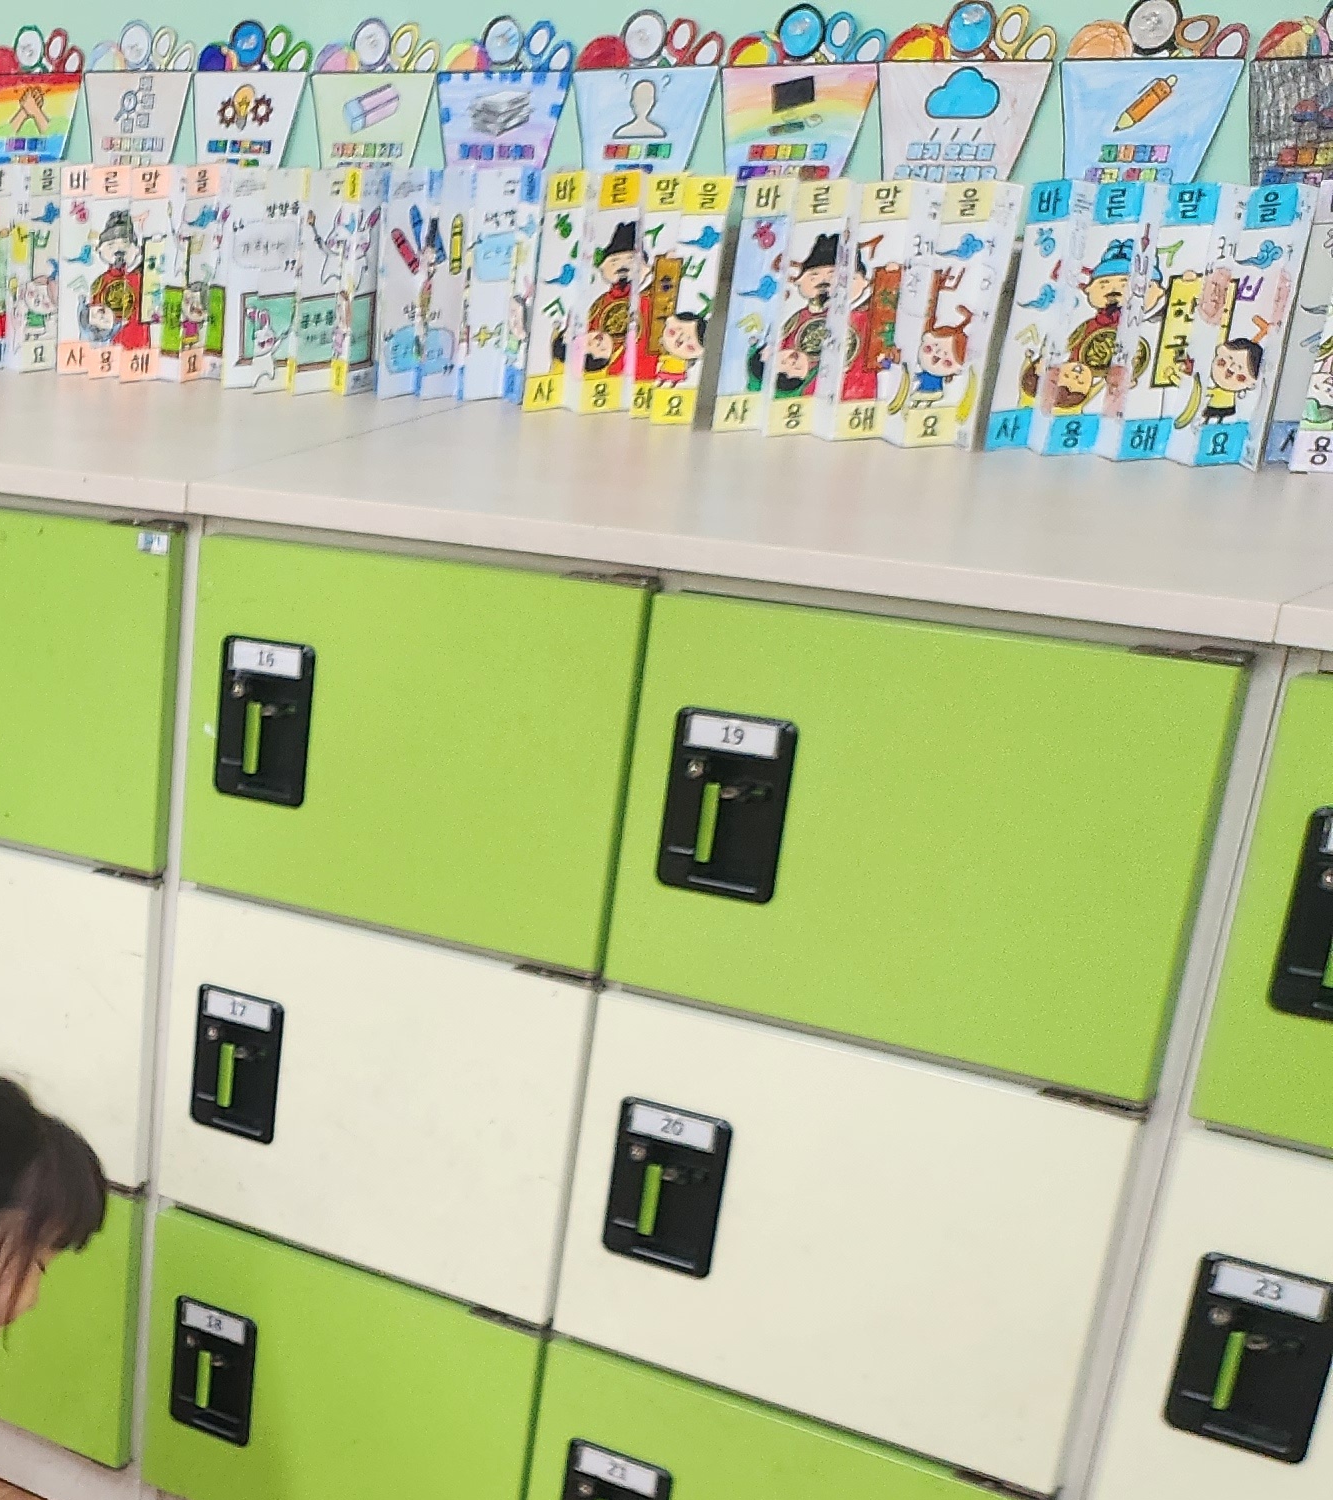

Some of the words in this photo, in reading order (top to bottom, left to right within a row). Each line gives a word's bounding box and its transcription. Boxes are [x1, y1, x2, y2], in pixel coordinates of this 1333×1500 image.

[723, 403, 939, 439] 사용해요
[996, 417, 1229, 456] 사용해요
[257, 650, 274, 667] 16
[720, 726, 744, 745] 19
[229, 1000, 245, 1016] 17
[660, 1117, 684, 1137] 20
[1252, 1277, 1282, 1300] 23
